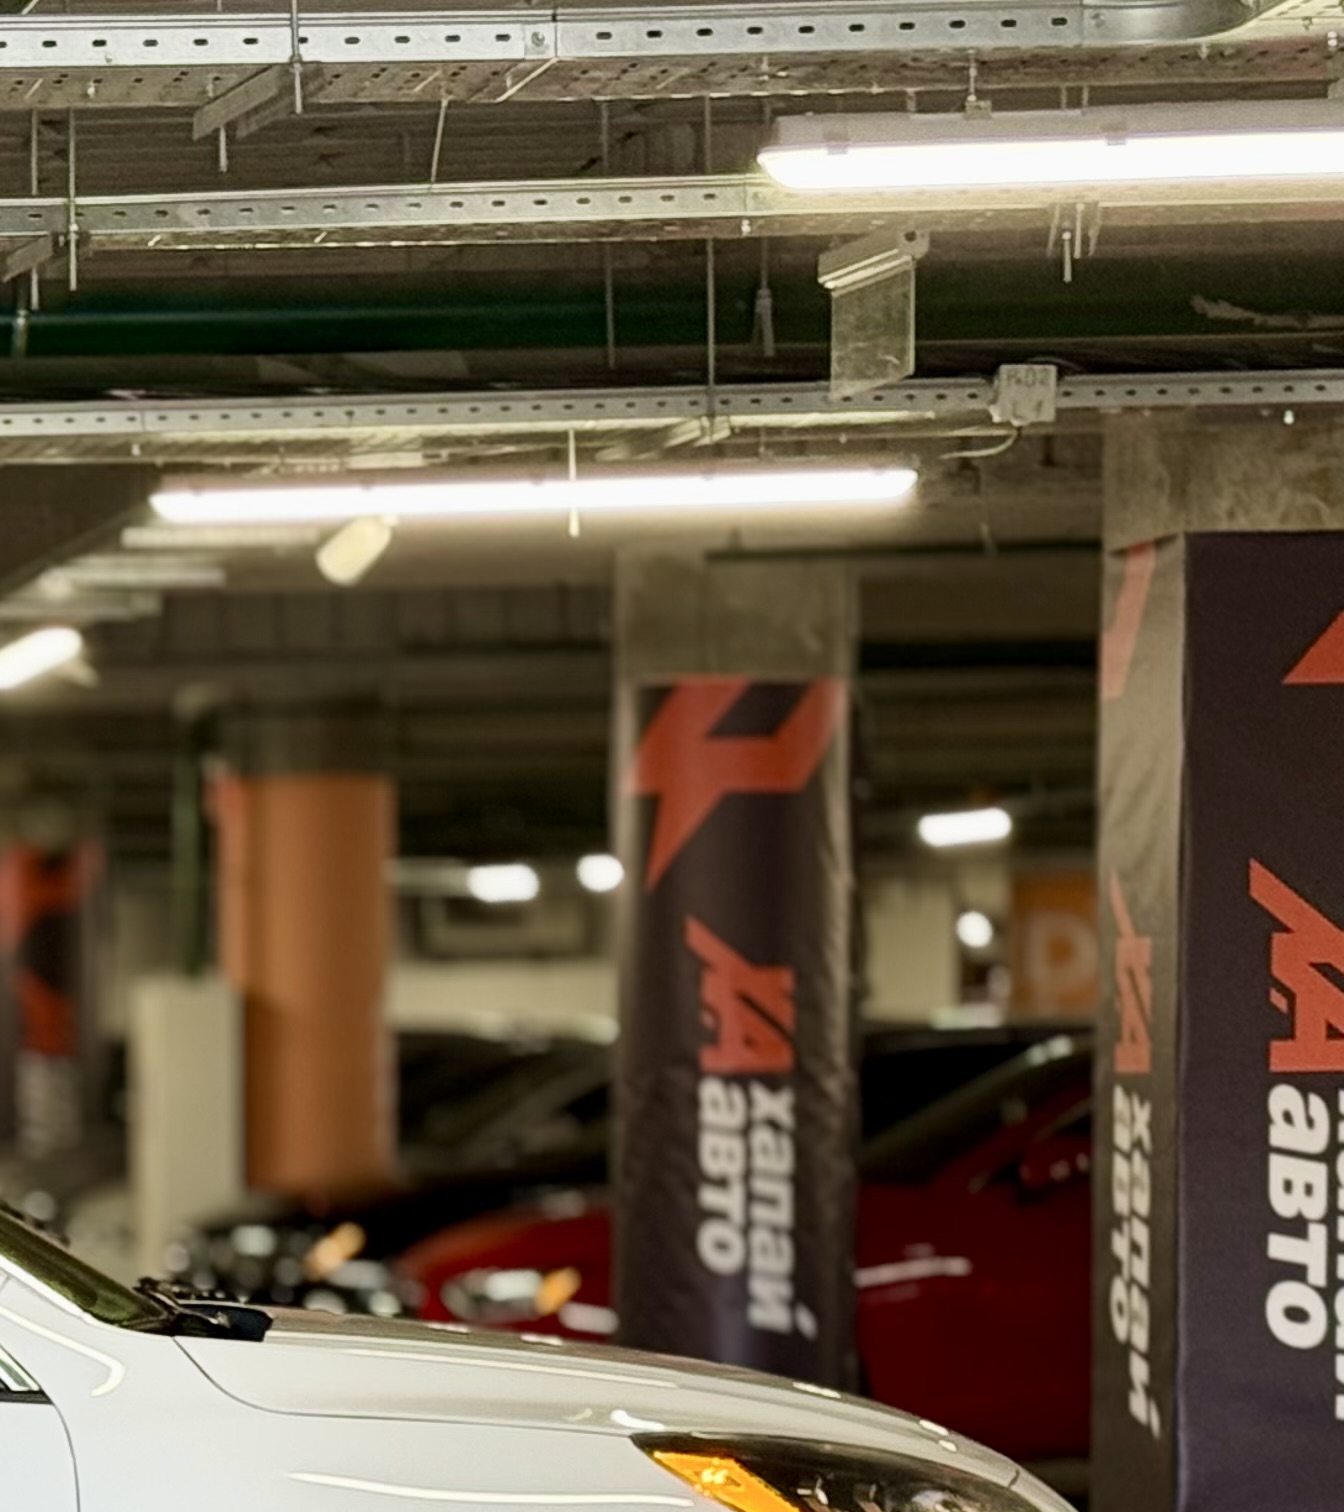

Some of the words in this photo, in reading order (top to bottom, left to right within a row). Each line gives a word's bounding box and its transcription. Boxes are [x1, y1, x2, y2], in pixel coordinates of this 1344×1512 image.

[696, 1077, 748, 1275] авто
[746, 1080, 818, 1340] хапай
[1265, 1084, 1330, 1350] авто
